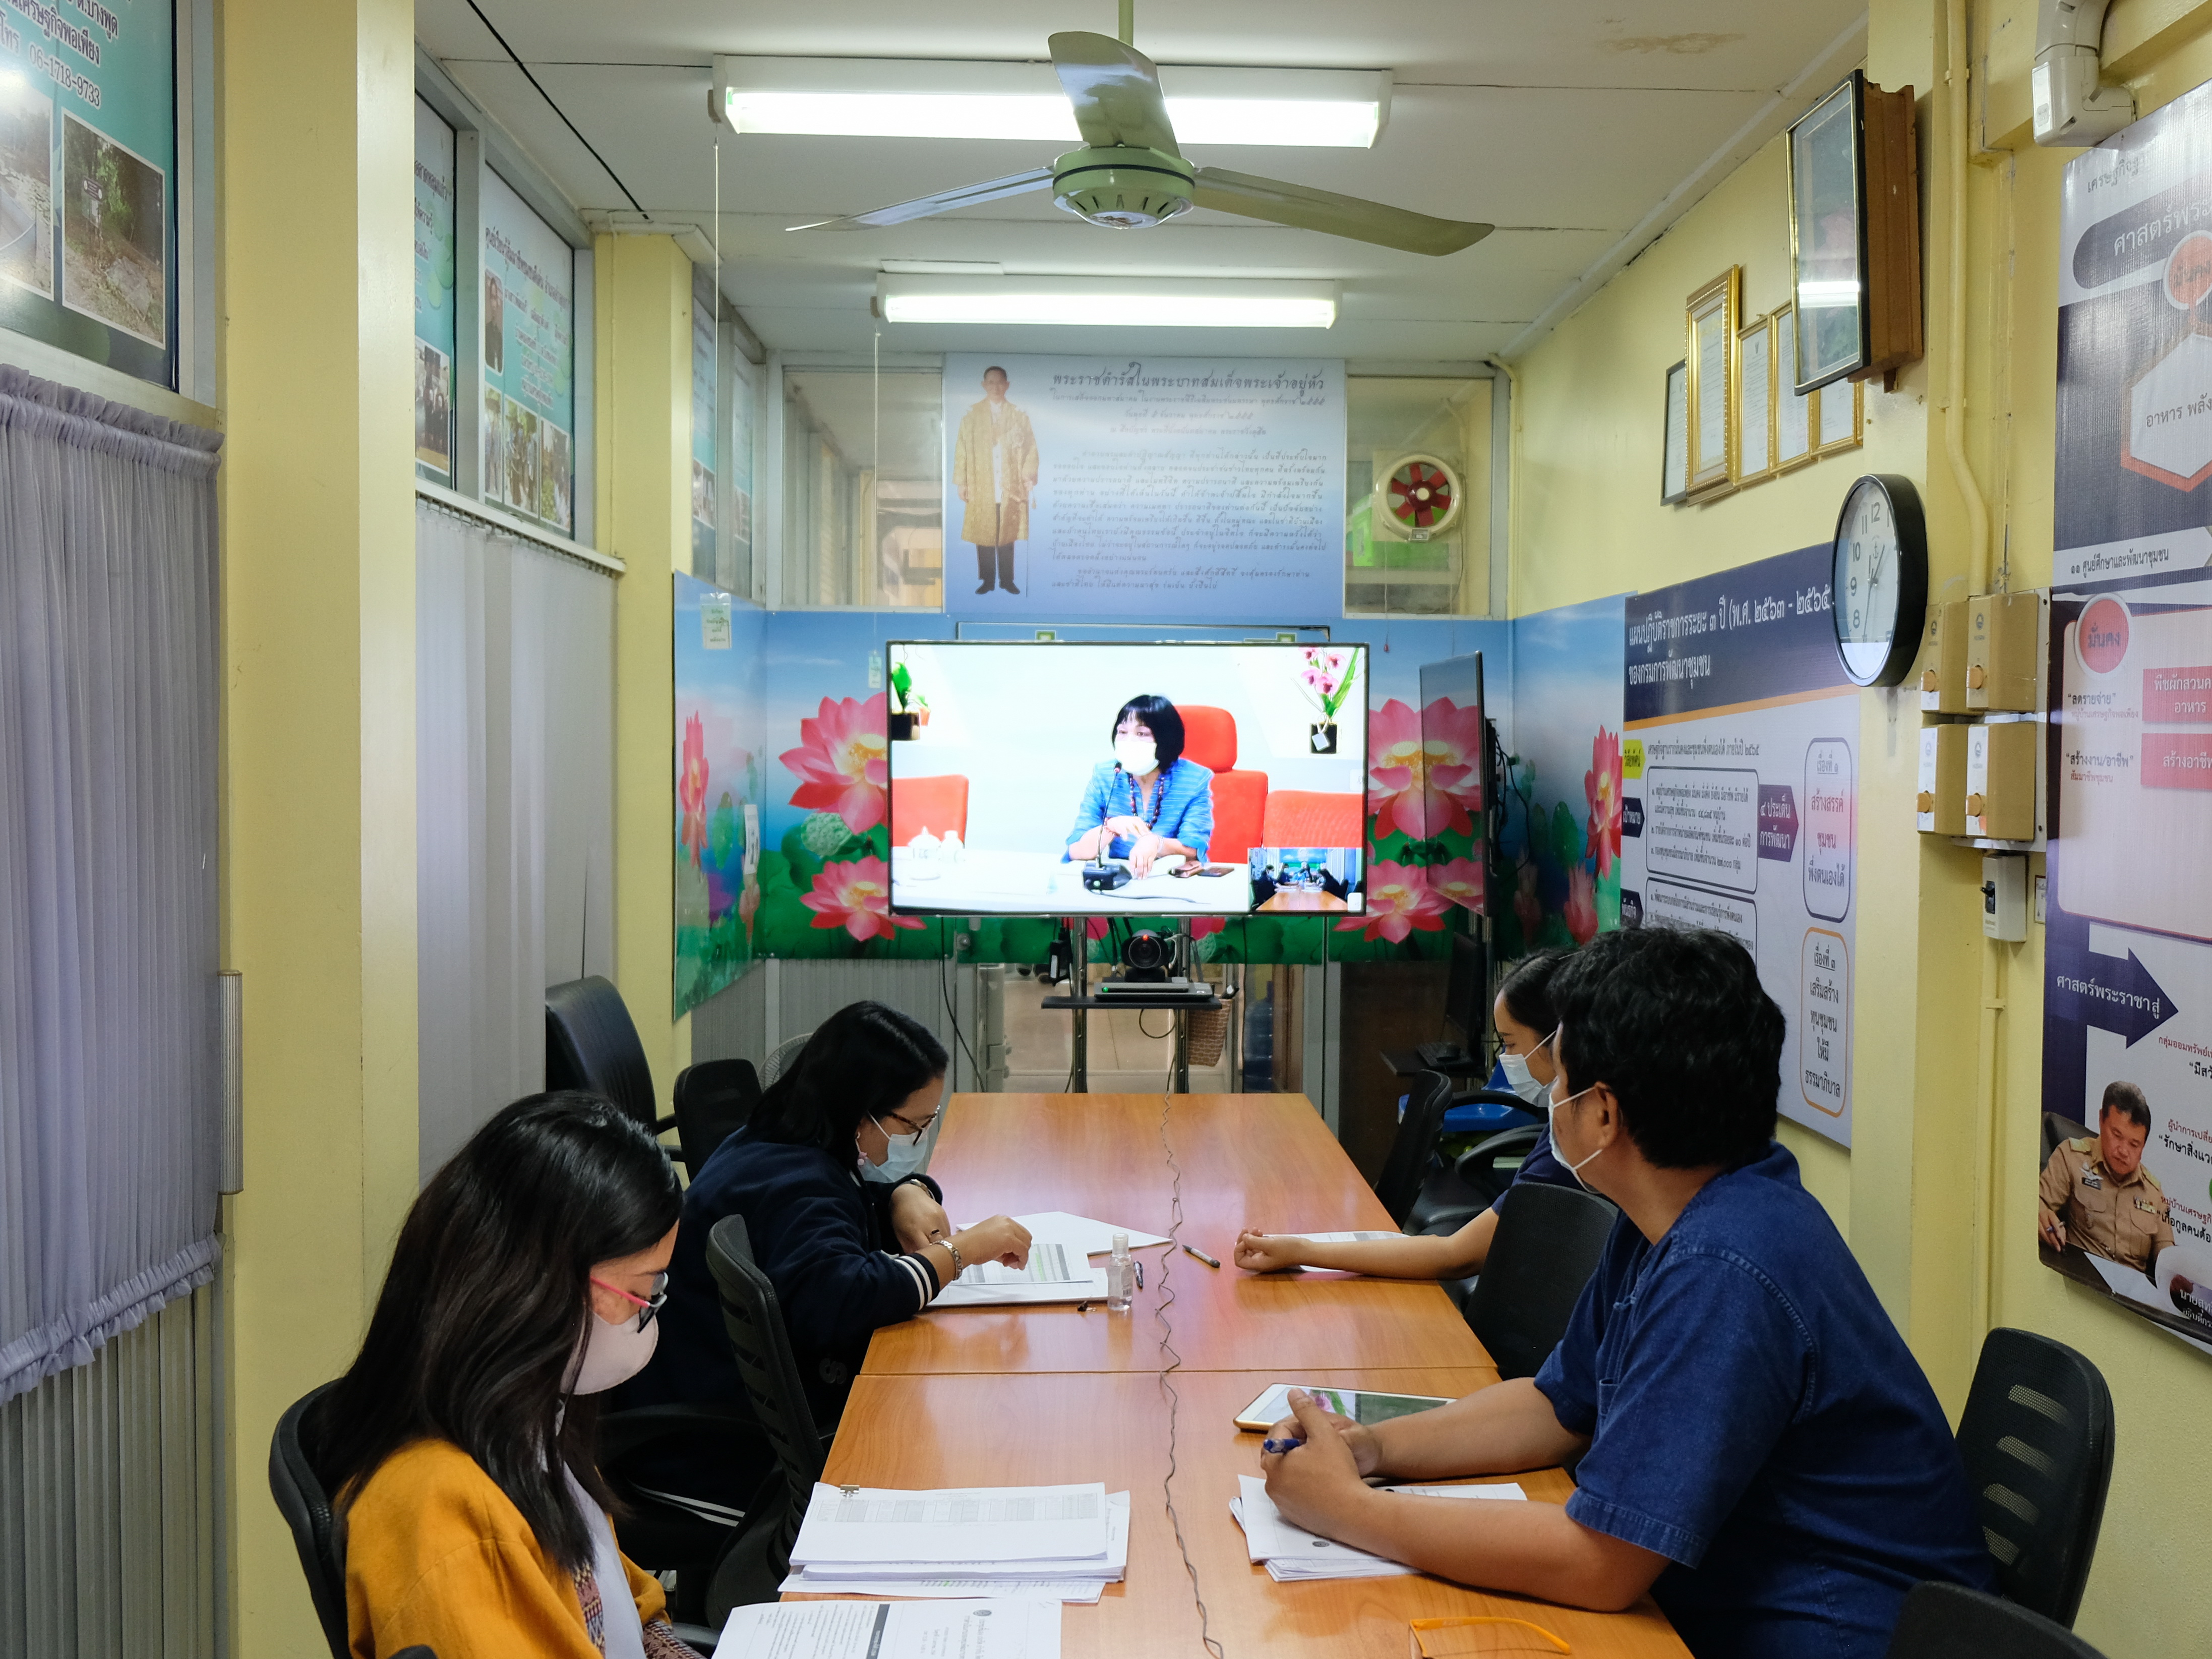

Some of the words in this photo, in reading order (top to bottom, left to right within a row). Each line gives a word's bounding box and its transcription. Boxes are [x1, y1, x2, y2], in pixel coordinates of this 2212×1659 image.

[8, 0, 100, 65] เศรษฐกิจพอเพียง
[30, 44, 100, 107] 06-1718-9733
[1053, 361, 1324, 396] พระราชดำรัสในพระบาทสมเด็จพระเจ้าอยู่หัว
[2146, 406, 2182, 428] อาหาร
[1862, 514, 1867, 535] 11
[1871, 502, 1880, 523] 12
[1853, 542, 1861, 562] 10
[2082, 547, 2169, 578] ศูนย์ศึกษาและพัฒนาชุมชน
[1850, 576, 1857, 597] 9
[1629, 611, 1707, 653] แผนปฏิบัติราชการระยะ
[1709, 614, 1716, 632] ๓
[1718, 595, 1726, 629] ปี
[1853, 609, 1860, 629] 8
[2088, 622, 2121, 648] มั่นคง
[1629, 649, 1710, 689] ของกรมการพัฒนาชุมชน
[2154, 674, 2212, 691] พืชผักสวนค
[2175, 702, 2206, 713] อาหาร
[1811, 787, 1844, 813] สร้างสรรค์
[1817, 832, 1837, 855] ชุมชน
[1808, 856, 1844, 887] พึ่งตนเองได้
[1810, 977, 1839, 1004] เสริมสร้าง
[2057, 975, 2160, 1019] ศาสตร์พระราชาสู่
[1805, 1069, 1840, 1097] ธรรมาภิบาล
[2159, 1134, 2212, 1165] “รักษาสิ่งแว
[2157, 1209, 2212, 1243] “เกื้อกูลคนด้อ
[2180, 1289, 2212, 1314] นายสุท
[2182, 1307, 2212, 1328] อธิบดีกร
